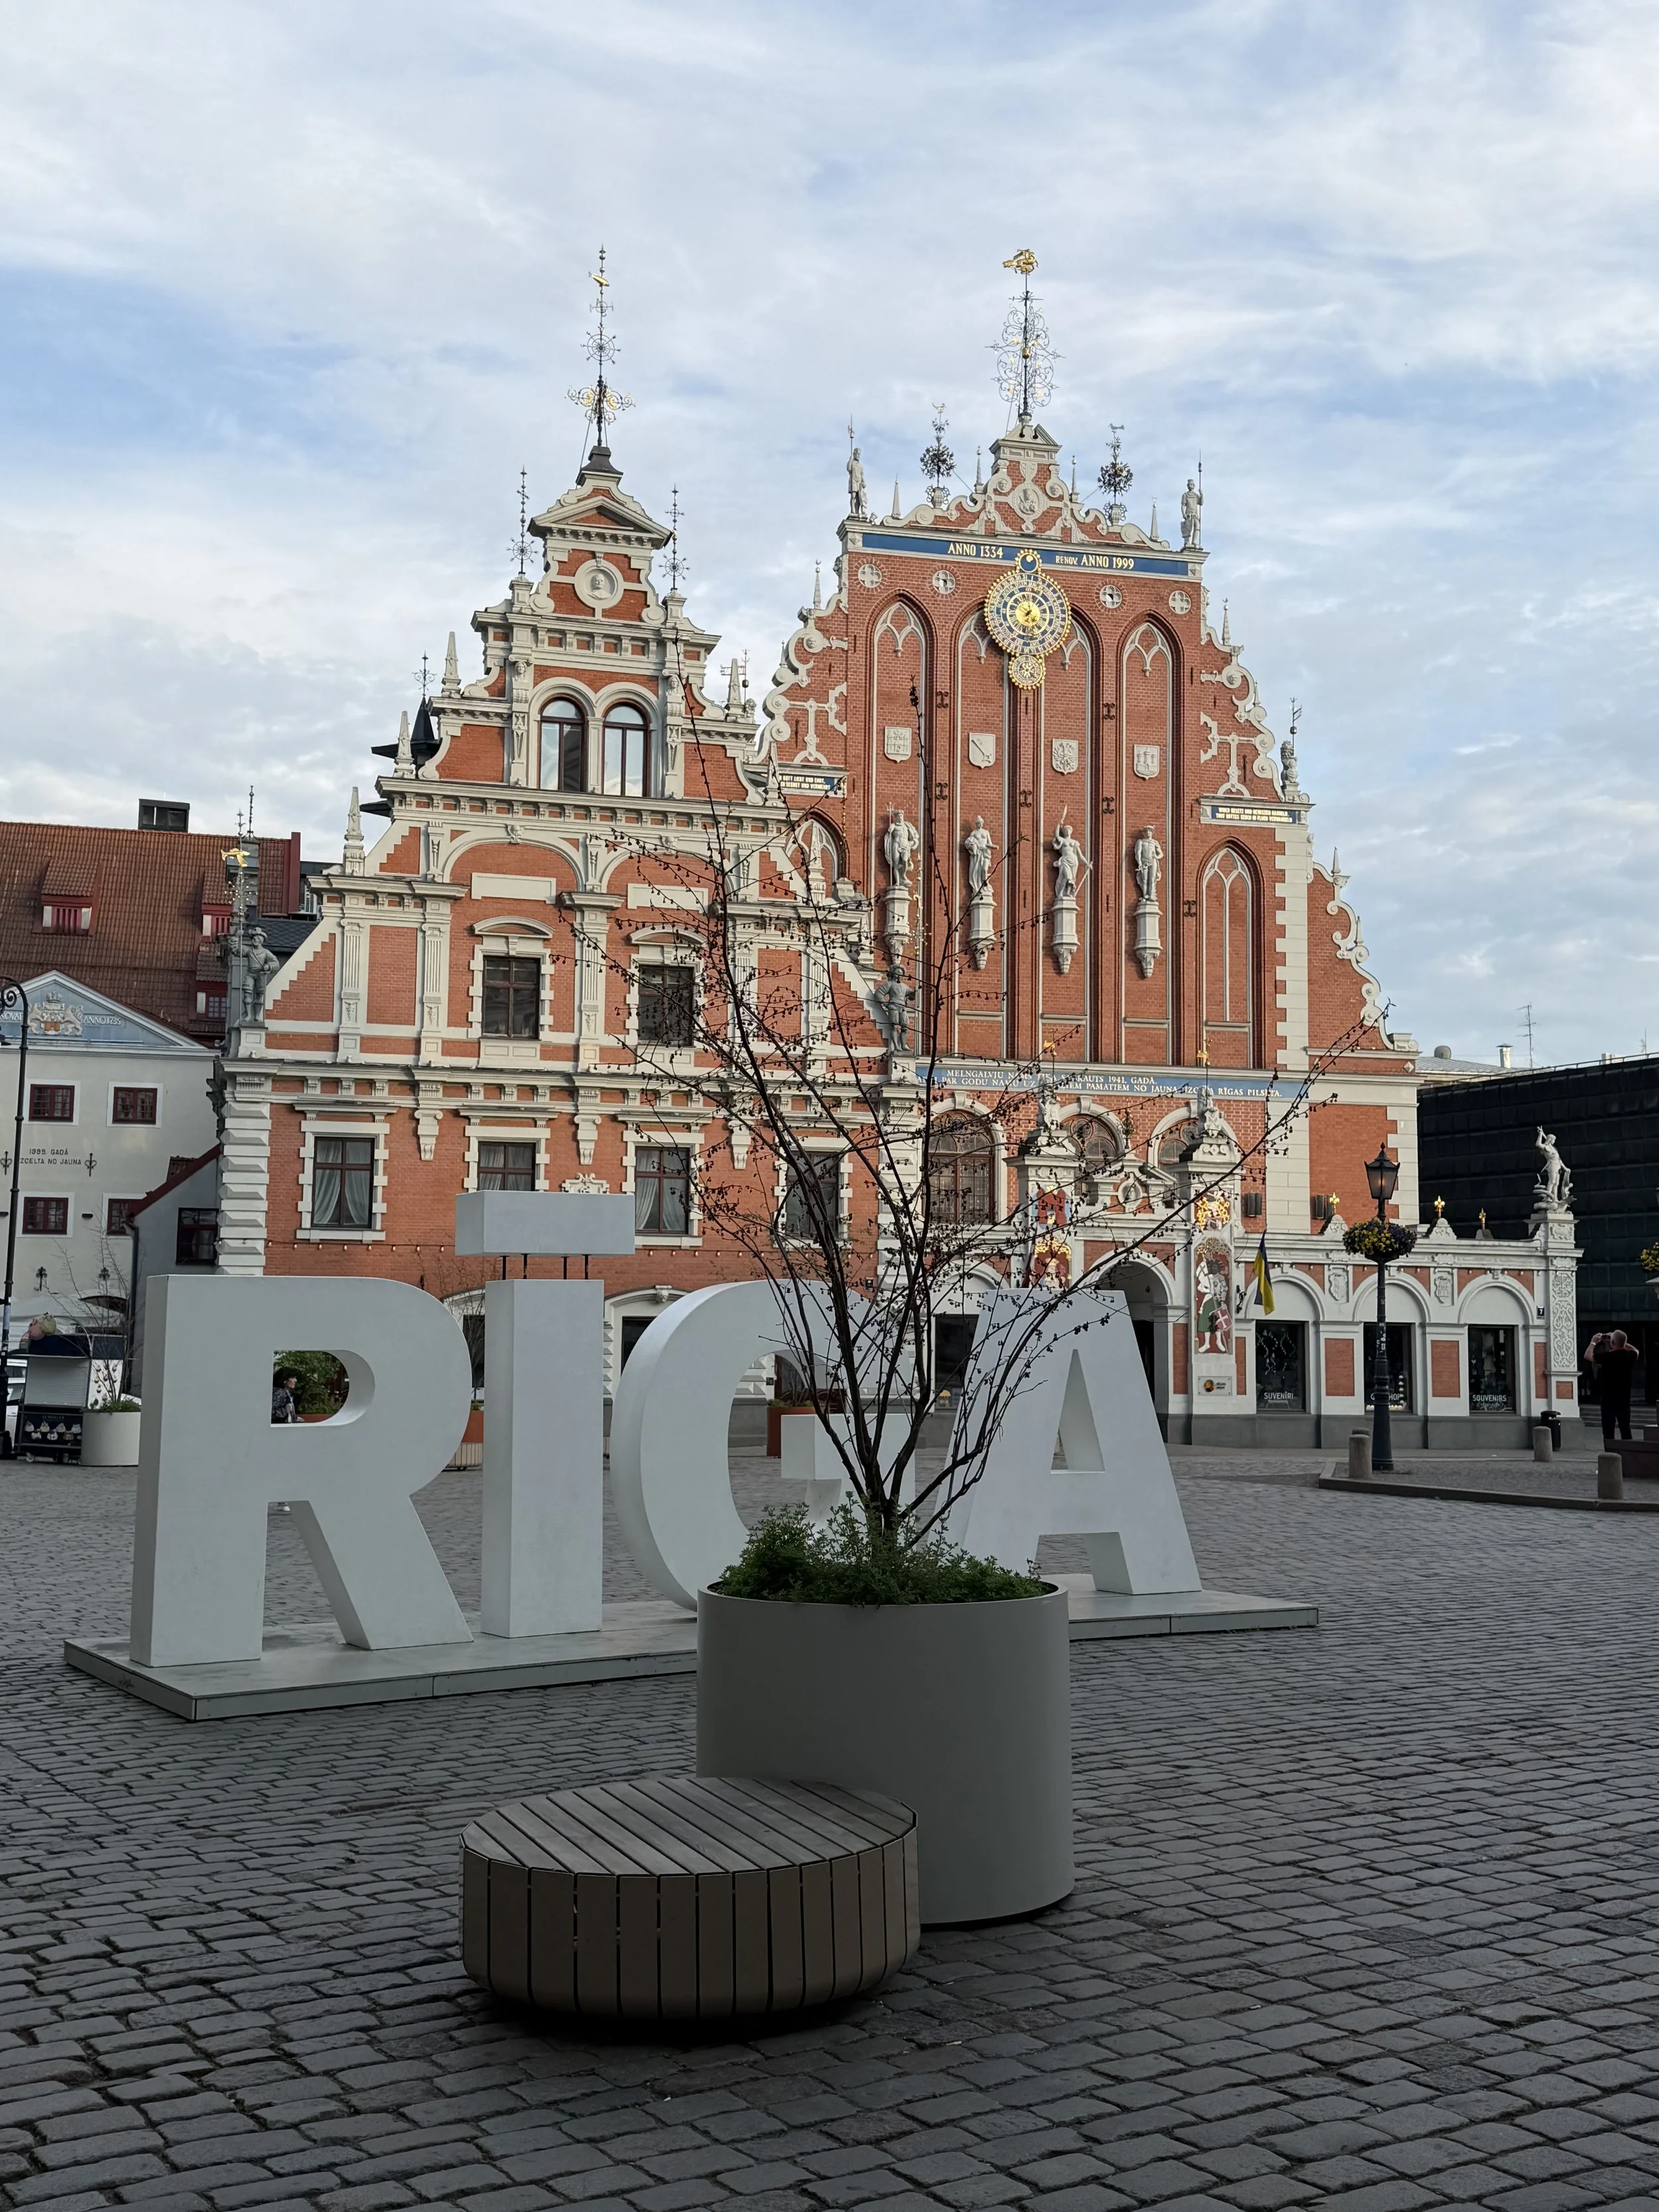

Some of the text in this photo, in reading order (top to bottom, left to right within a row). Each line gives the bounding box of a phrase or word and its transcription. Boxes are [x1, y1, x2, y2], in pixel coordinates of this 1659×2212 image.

[948, 542, 1003, 558] ANNO 1334
[1055, 554, 1134, 569] RENOV. ANNO 1999
[1086, 1082, 1129, 1091] PAMATIEM
[1218, 1087, 1243, 1096] RĪGAS
[1263, 1391, 1294, 1400] SUVENĪRI
